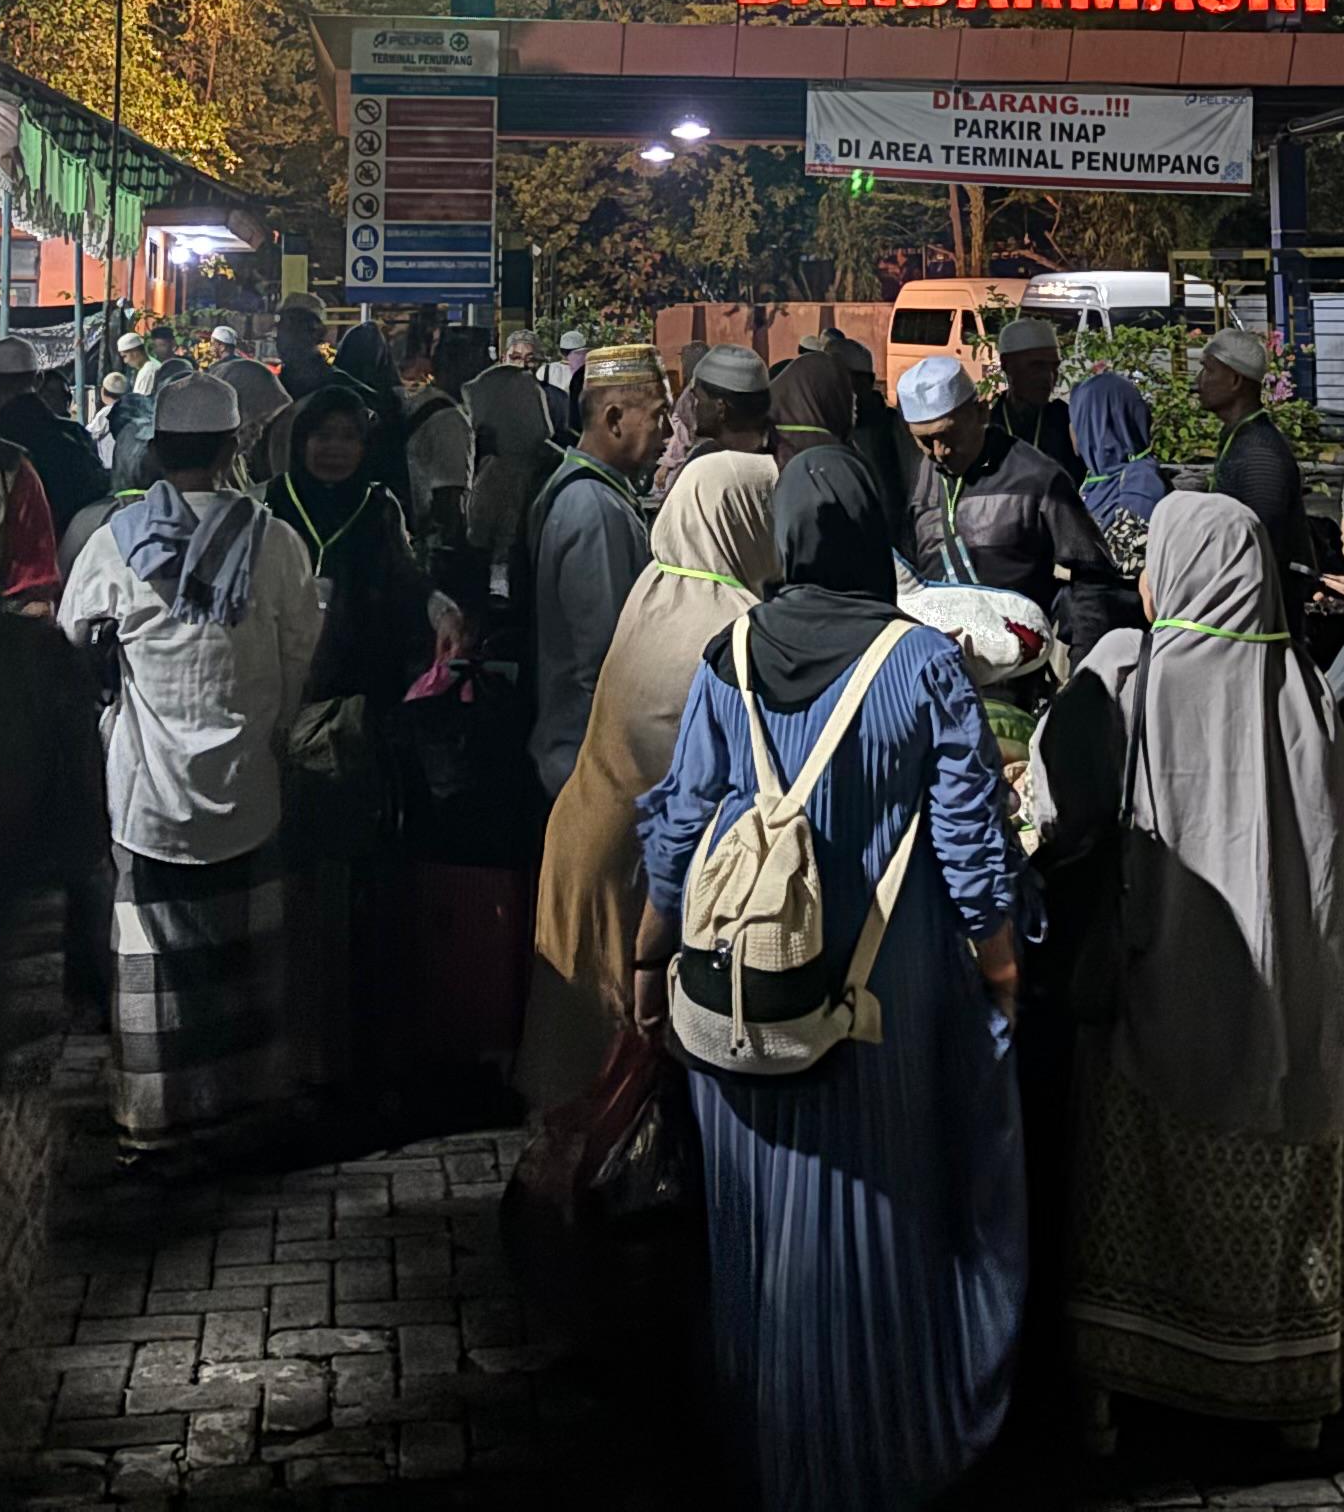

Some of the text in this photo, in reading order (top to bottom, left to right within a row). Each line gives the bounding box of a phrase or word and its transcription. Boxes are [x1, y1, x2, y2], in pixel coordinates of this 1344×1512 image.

[372, 53, 473, 66] TERMINAL PENUMPANG
[953, 118, 1106, 144] PARKIR INAP
[838, 138, 1220, 175] DI AREA TERMINAL PENUMPANG
